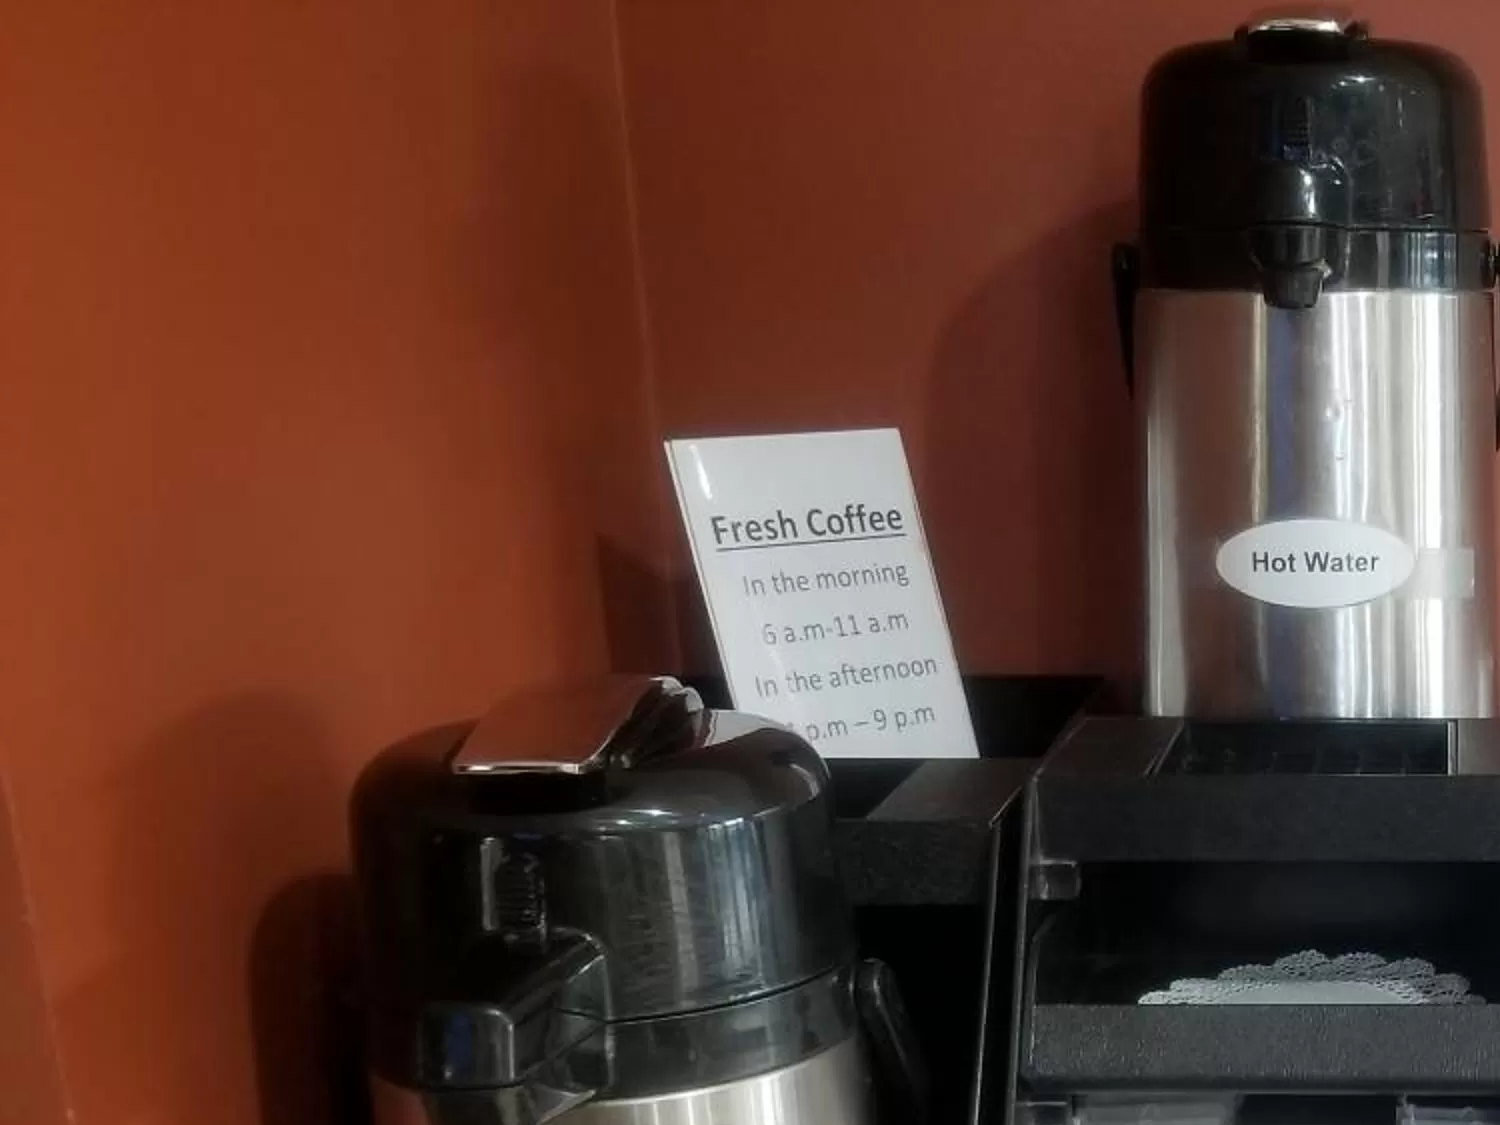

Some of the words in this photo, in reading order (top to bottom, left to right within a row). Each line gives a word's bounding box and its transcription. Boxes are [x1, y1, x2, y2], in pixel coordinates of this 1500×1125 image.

[710, 509, 799, 546] Fresh
[806, 503, 904, 537] Coffee
[1252, 551, 1297, 573] Hot
[1304, 551, 1380, 573] Water
[743, 575, 766, 597] In
[772, 571, 810, 594] the
[816, 563, 910, 588] morning
[763, 623, 777, 646] 6
[784, 614, 861, 644] a.m-11
[868, 612, 910, 634] a.m
[755, 675, 779, 698] In
[785, 671, 824, 694] the
[829, 657, 938, 688] afternoon
[806, 718, 849, 743] p.m
[894, 706, 936, 728] p.m
